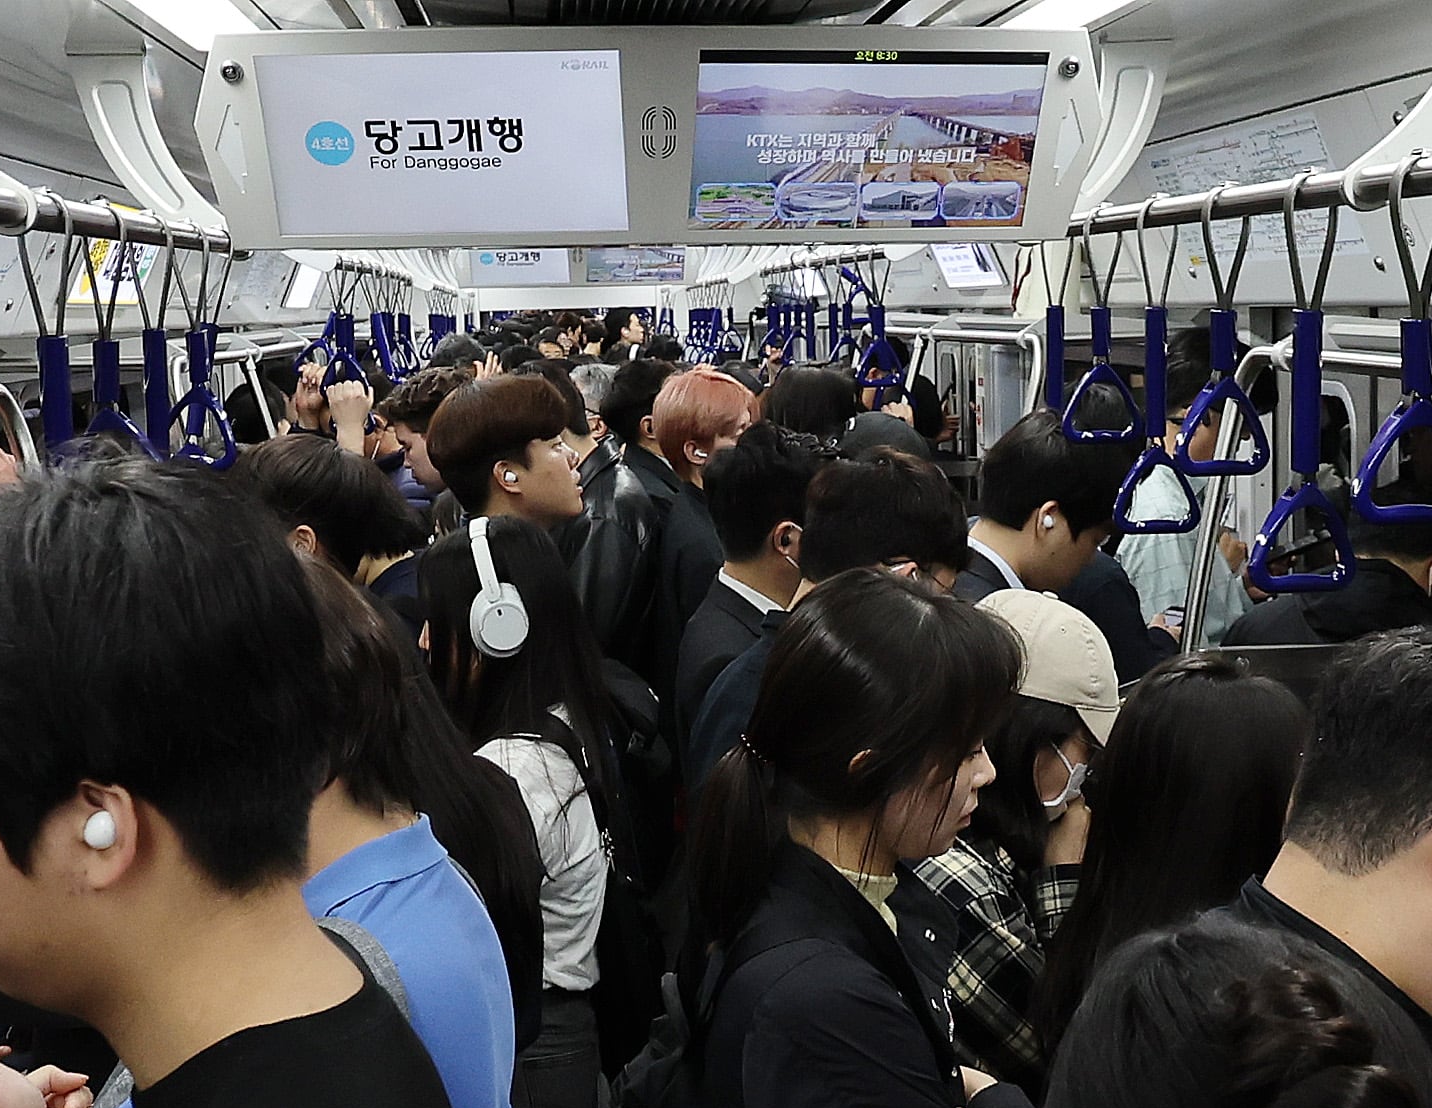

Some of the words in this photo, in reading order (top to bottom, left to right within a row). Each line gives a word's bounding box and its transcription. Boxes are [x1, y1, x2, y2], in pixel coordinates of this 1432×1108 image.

[854, 50, 874, 61] 오전
[876, 51, 898, 61] 8:30
[364, 116, 524, 155] 당고개행
[747, 134, 793, 148] KTX는
[797, 133, 844, 148] 지역과
[311, 137, 350, 151] 4호선
[757, 149, 817, 164] 성장하며
[822, 149, 866, 164] 역사를
[870, 149, 913, 164] 만들어
[917, 147, 977, 164] 냈습니다
[370, 156, 397, 169] For
[404, 156, 502, 171] Danggogae
[495, 252, 540, 262] 당고개행
